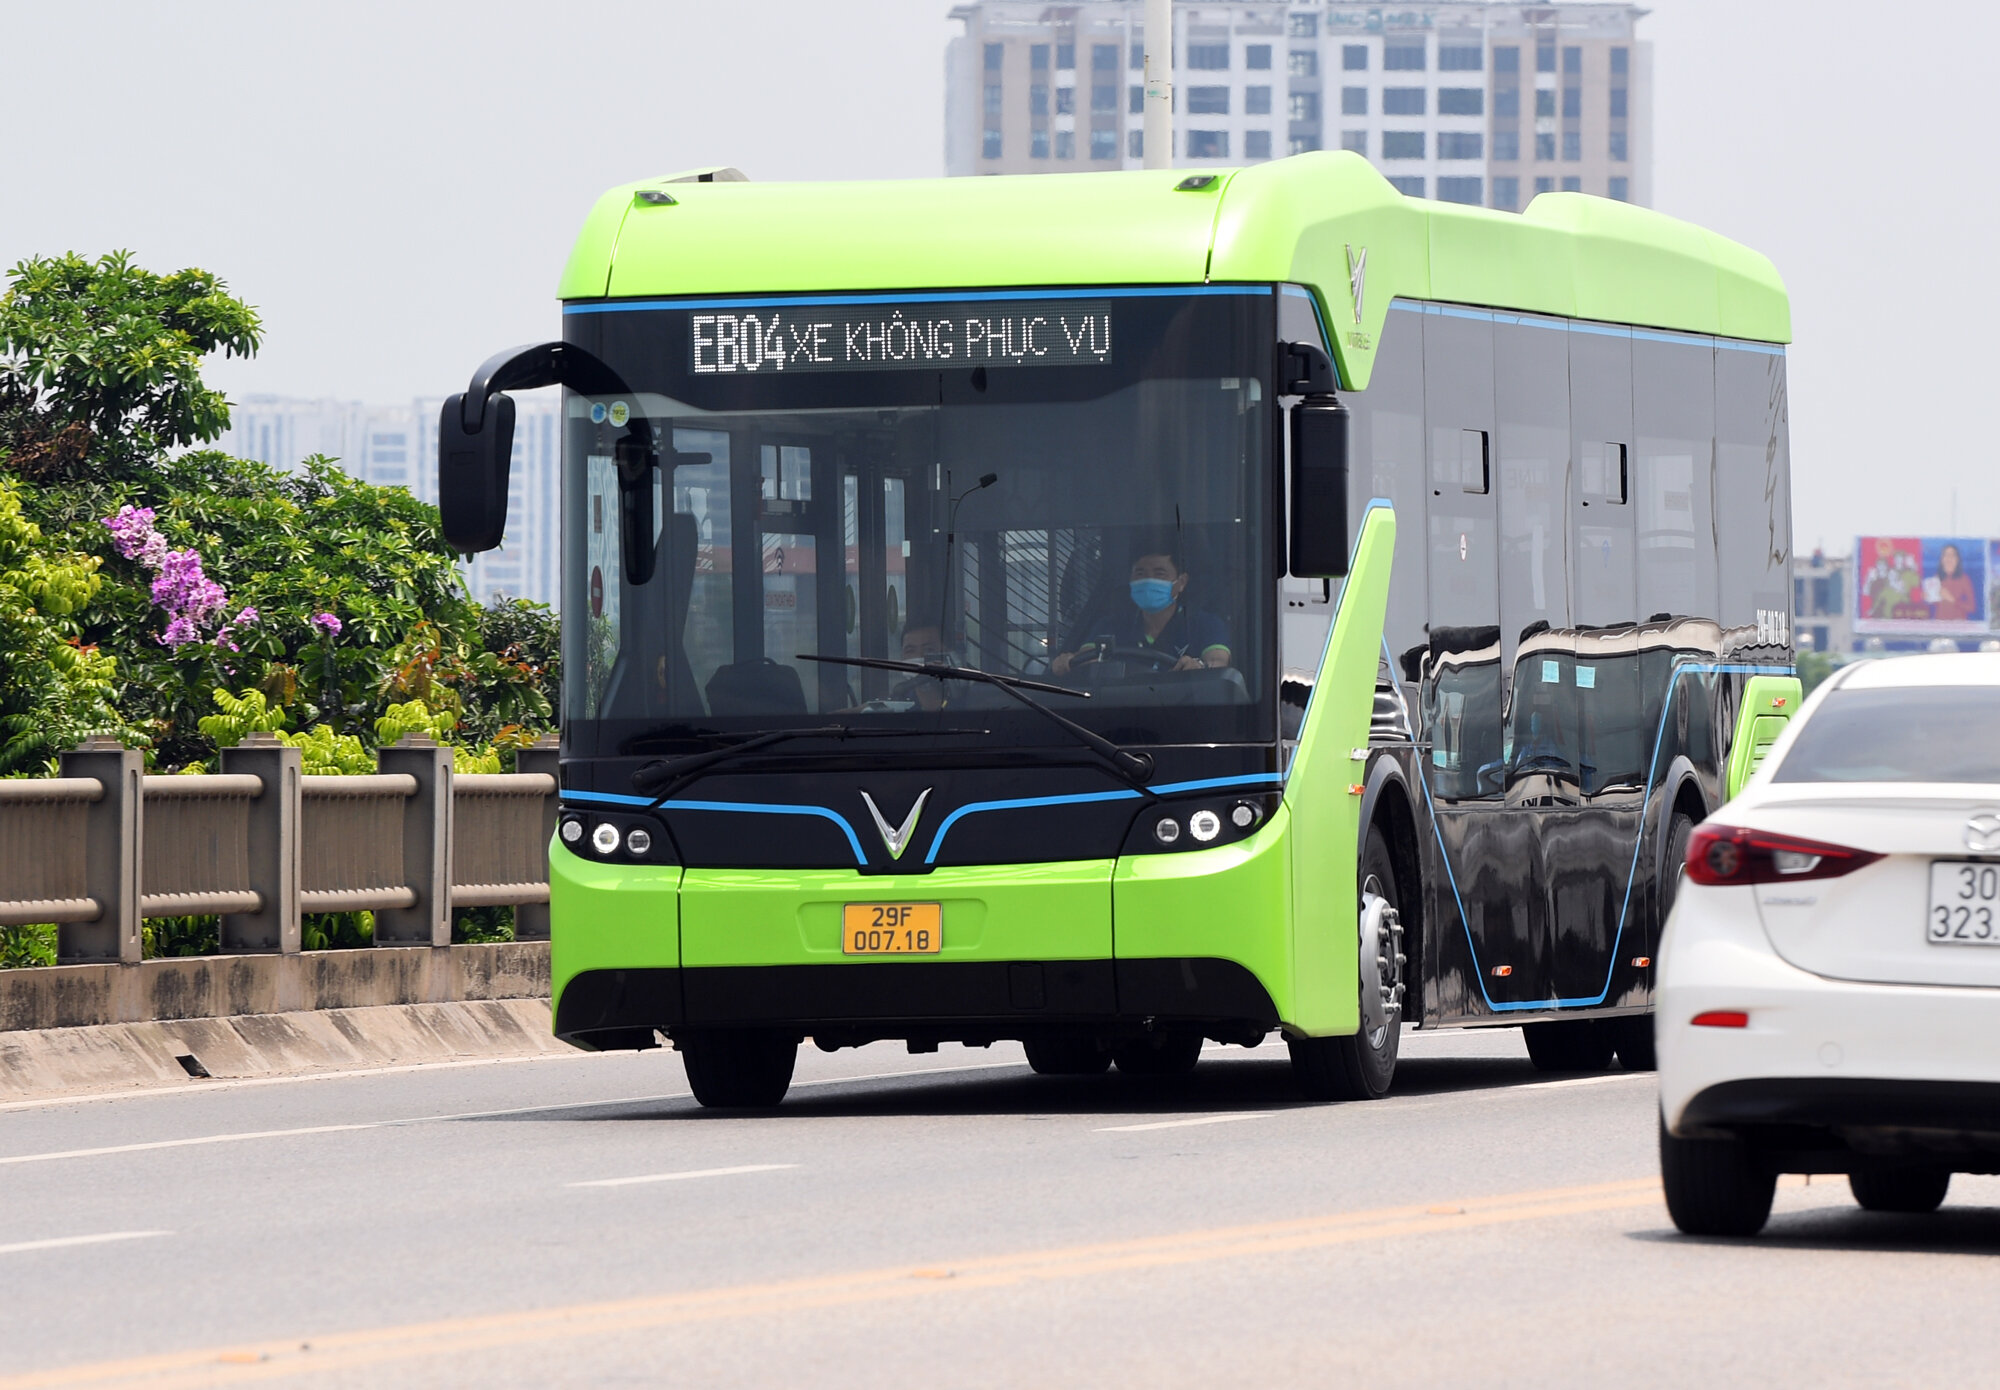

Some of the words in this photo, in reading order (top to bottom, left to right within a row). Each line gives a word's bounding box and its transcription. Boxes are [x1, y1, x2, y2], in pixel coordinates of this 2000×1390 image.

[693, 313, 786, 373] EB04
[790, 323, 833, 362] XE
[846, 310, 954, 361] KHÔNG
[966, 316, 1048, 364] PHỤC
[1060, 315, 1111, 362] VỤ
[1958, 866, 2000, 901] 30
[872, 907, 913, 927] 29F
[854, 930, 930, 951] 007.18
